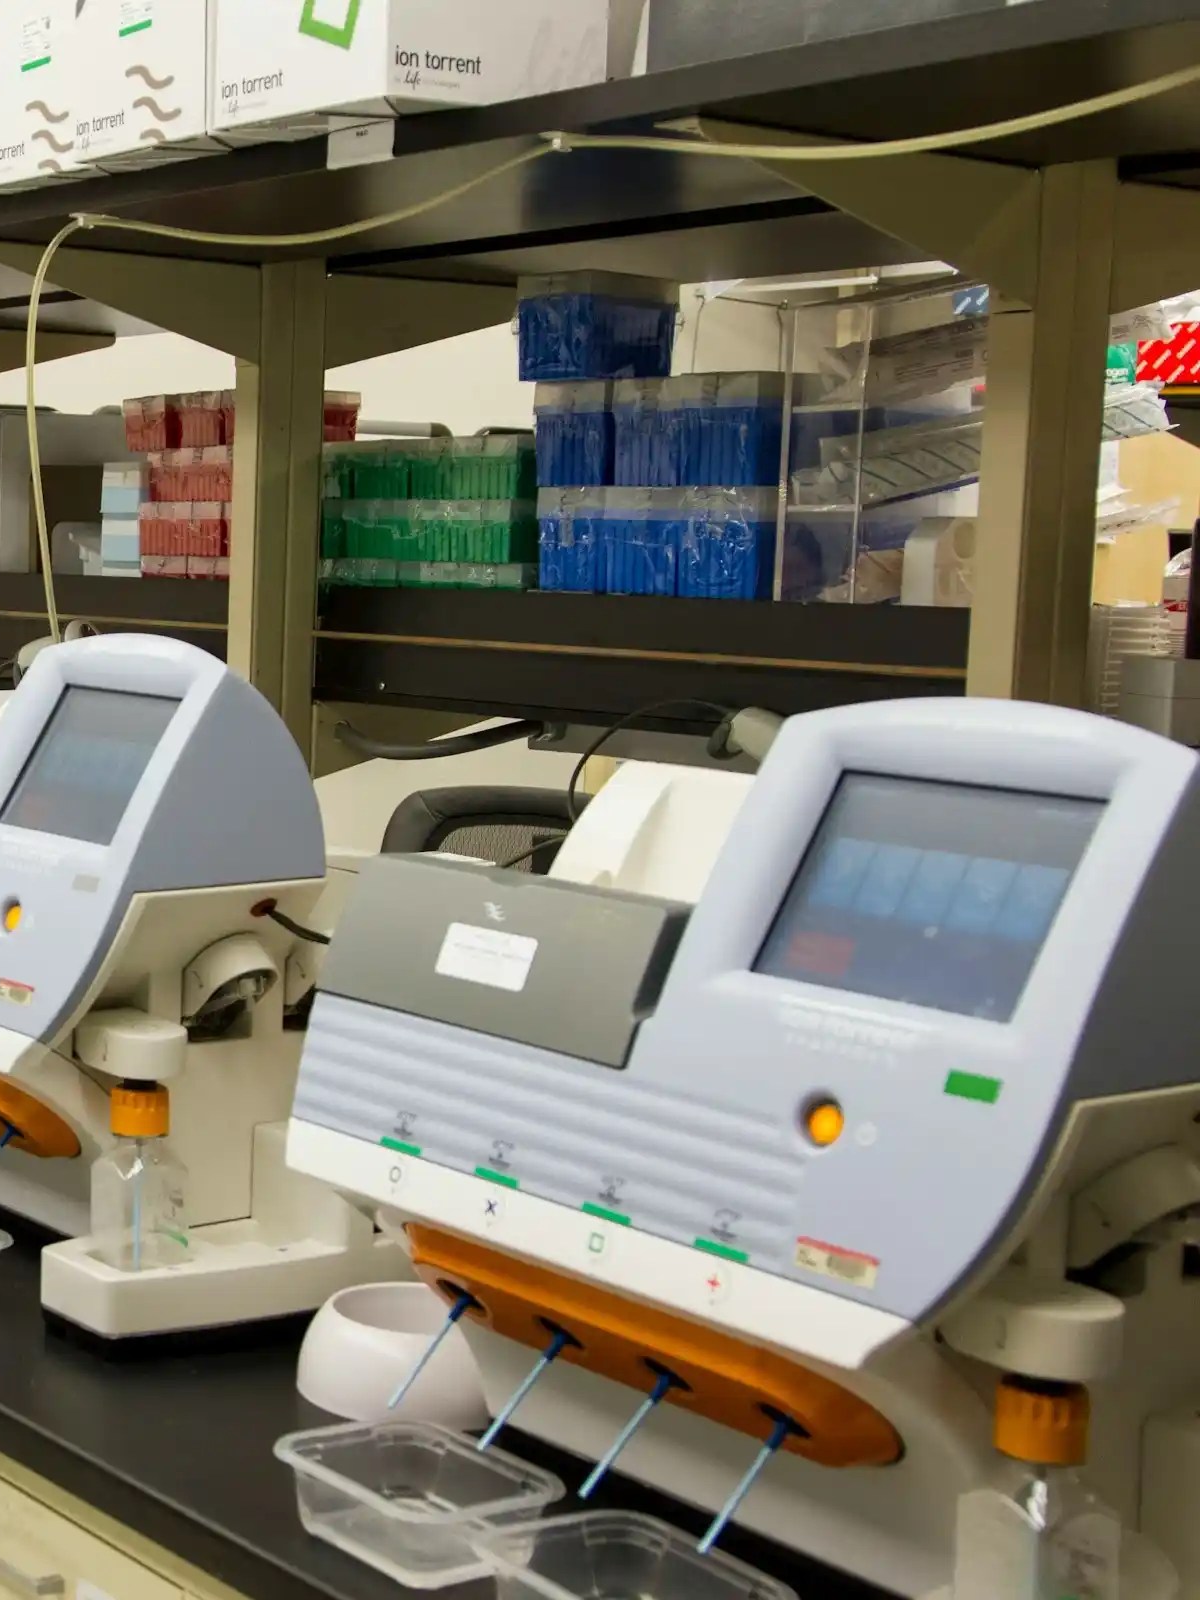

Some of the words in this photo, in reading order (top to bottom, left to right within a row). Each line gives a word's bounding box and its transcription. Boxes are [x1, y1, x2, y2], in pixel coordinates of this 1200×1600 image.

[395, 45, 419, 68] ion
[425, 49, 482, 76] torrent
[221, 81, 238, 99] ion
[242, 68, 284, 95] torrent
[76, 119, 90, 136] ion
[92, 109, 125, 133] torrent
